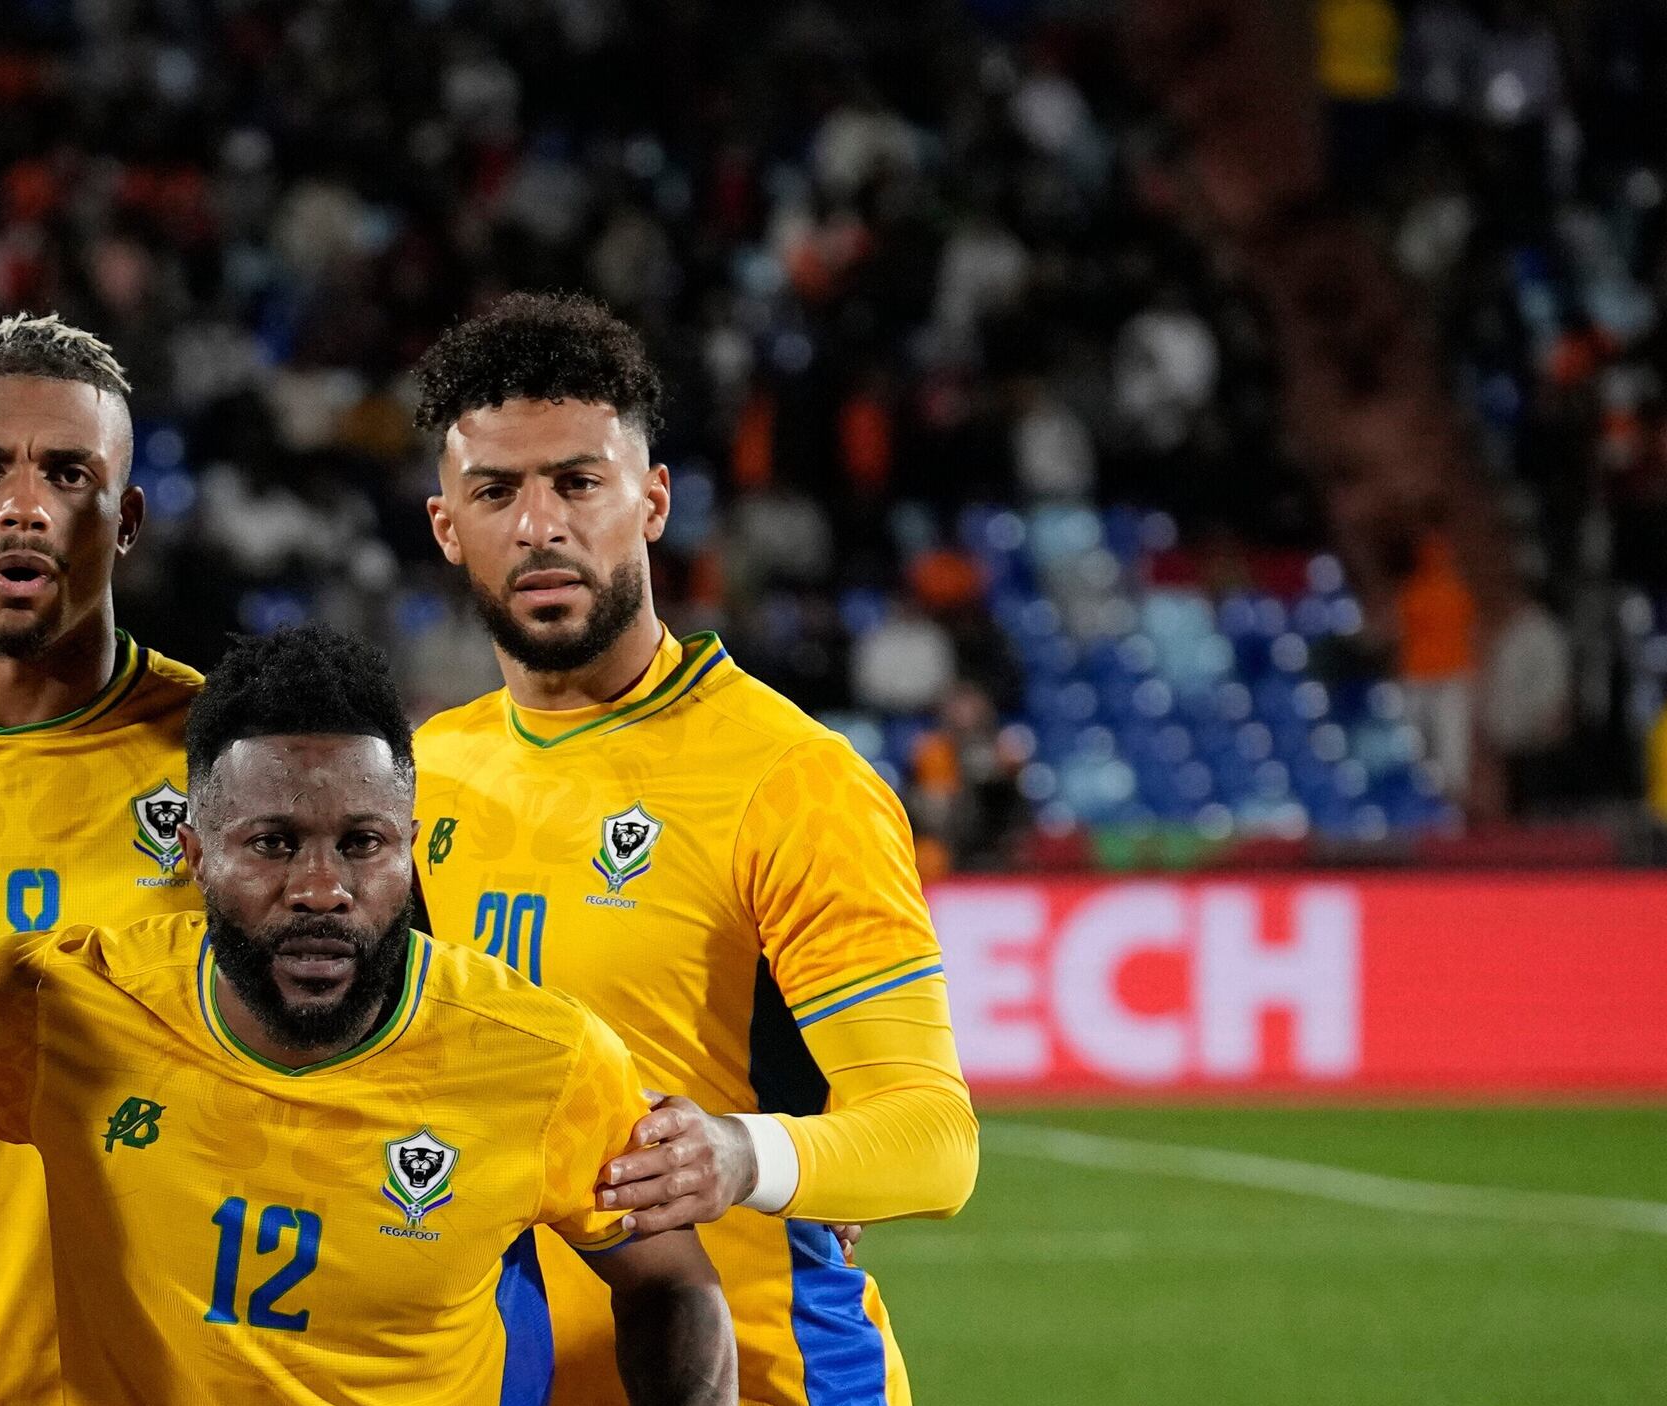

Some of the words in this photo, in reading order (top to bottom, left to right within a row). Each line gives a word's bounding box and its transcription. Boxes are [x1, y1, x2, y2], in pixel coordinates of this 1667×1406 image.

[136, 878, 190, 888] FEGAFOOT
[585, 895, 637, 909] FEGAFOOT
[379, 1224, 441, 1242] FEGAFOOT
[204, 1195, 323, 1332] 12
